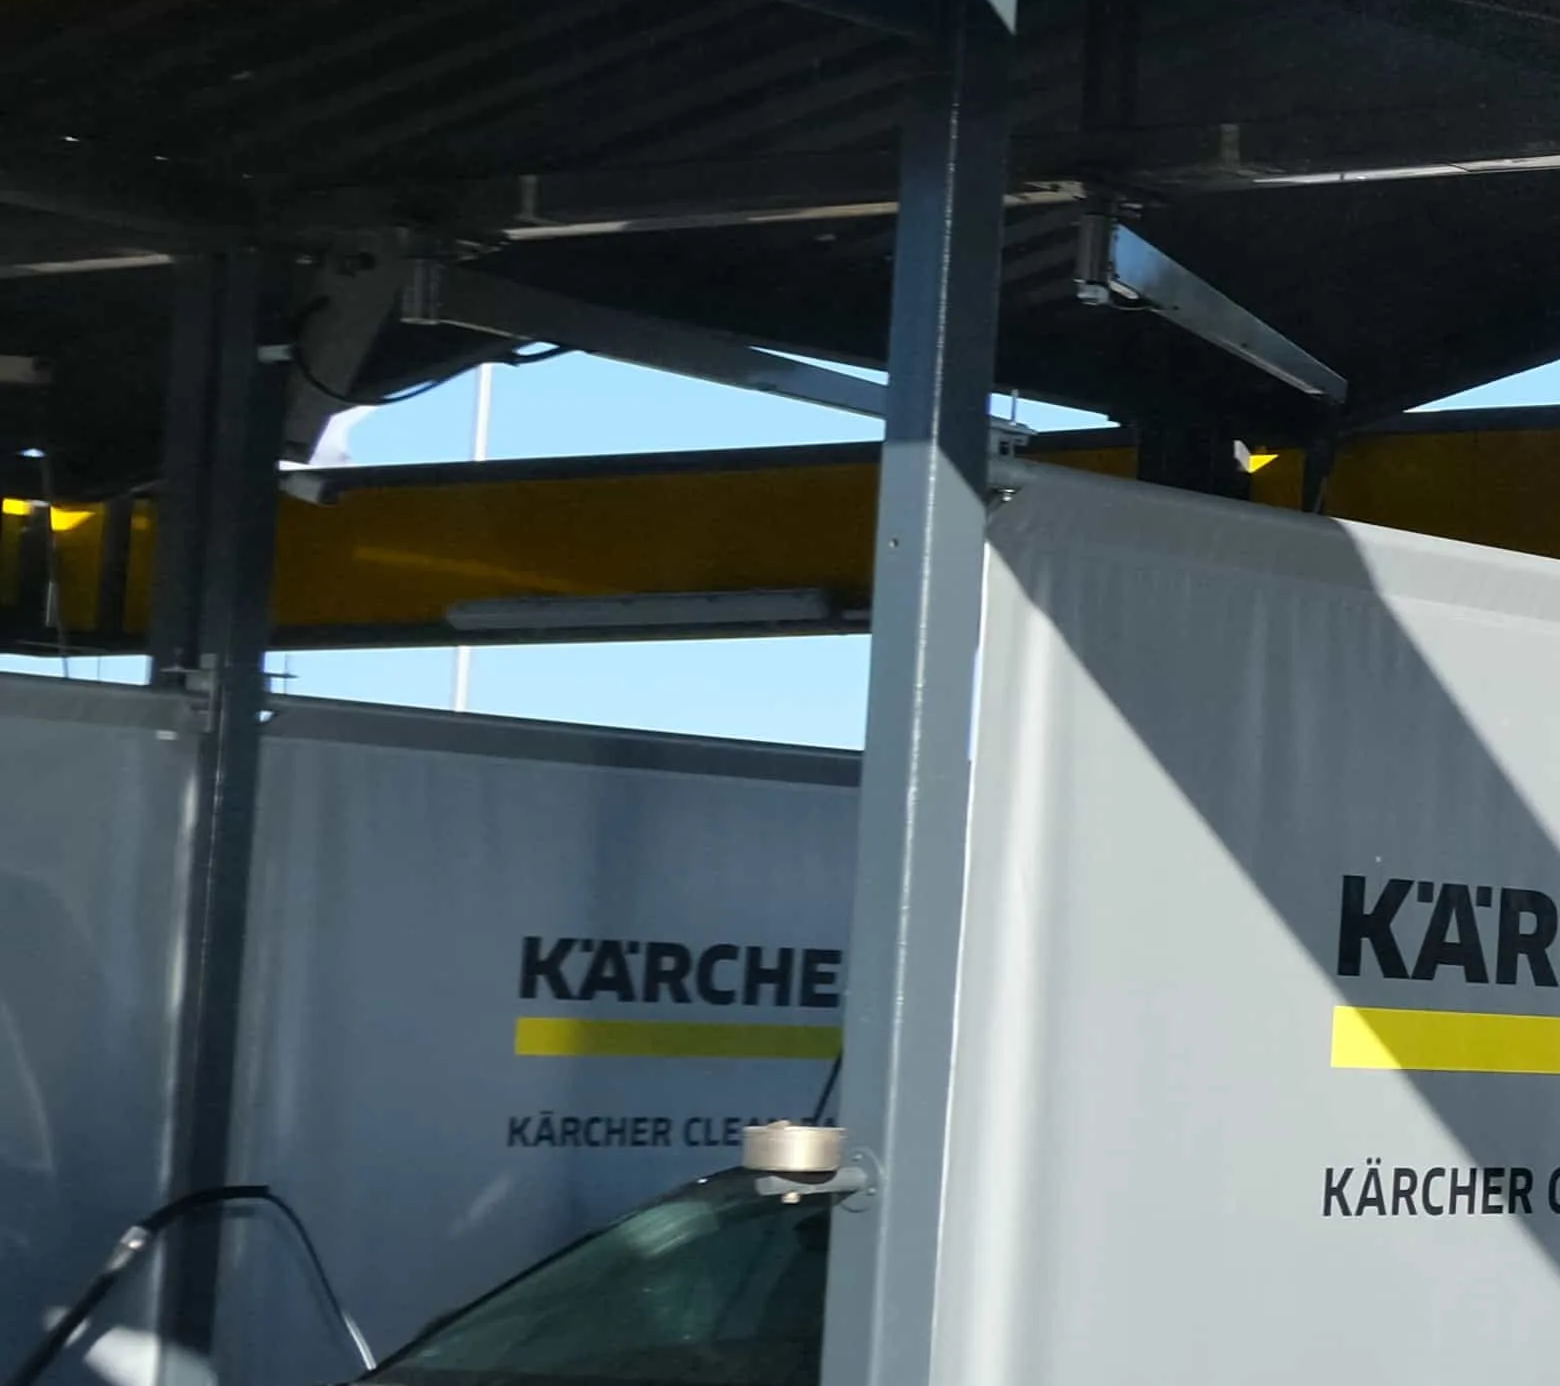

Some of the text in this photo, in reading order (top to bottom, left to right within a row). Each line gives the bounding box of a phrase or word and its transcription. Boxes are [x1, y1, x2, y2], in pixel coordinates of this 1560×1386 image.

[519, 935, 843, 1008] KÄRCHE
[505, 1110, 672, 1149] KÄRCHER
[1321, 1156, 1533, 1217] KÄRCHER
